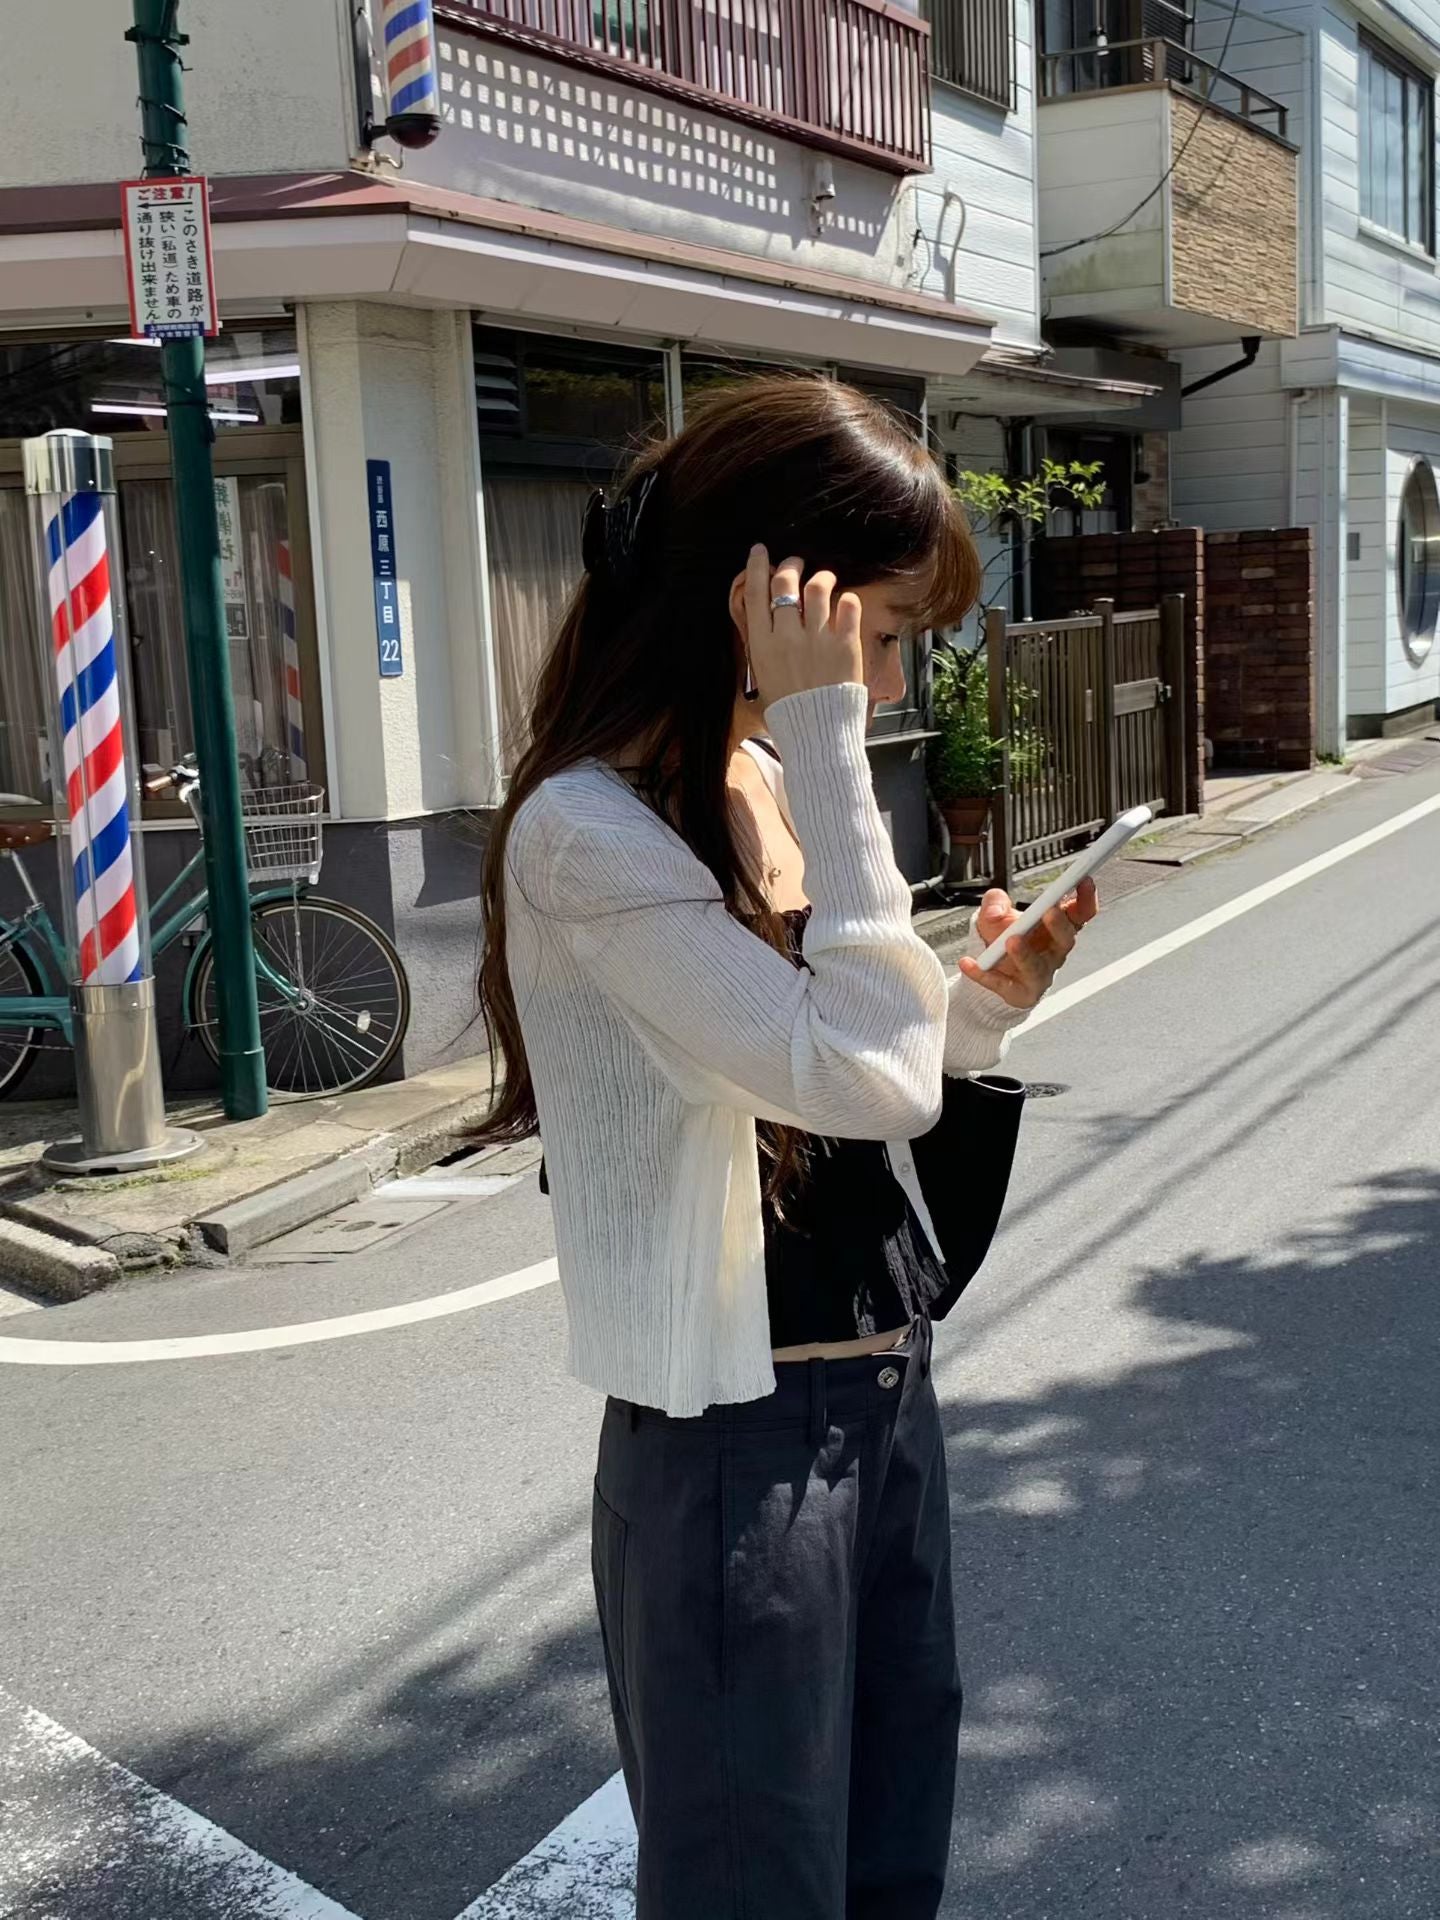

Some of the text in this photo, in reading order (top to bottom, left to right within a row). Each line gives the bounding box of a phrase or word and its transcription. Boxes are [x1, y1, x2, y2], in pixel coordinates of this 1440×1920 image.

[138, 186, 193, 200] ご注意!
[137, 212, 161, 320] 通り抜け出来ません
[159, 210, 182, 319] 狭い(私道)ため車の
[182, 209, 204, 317] このさき道路が
[382, 639, 400, 662] 22
